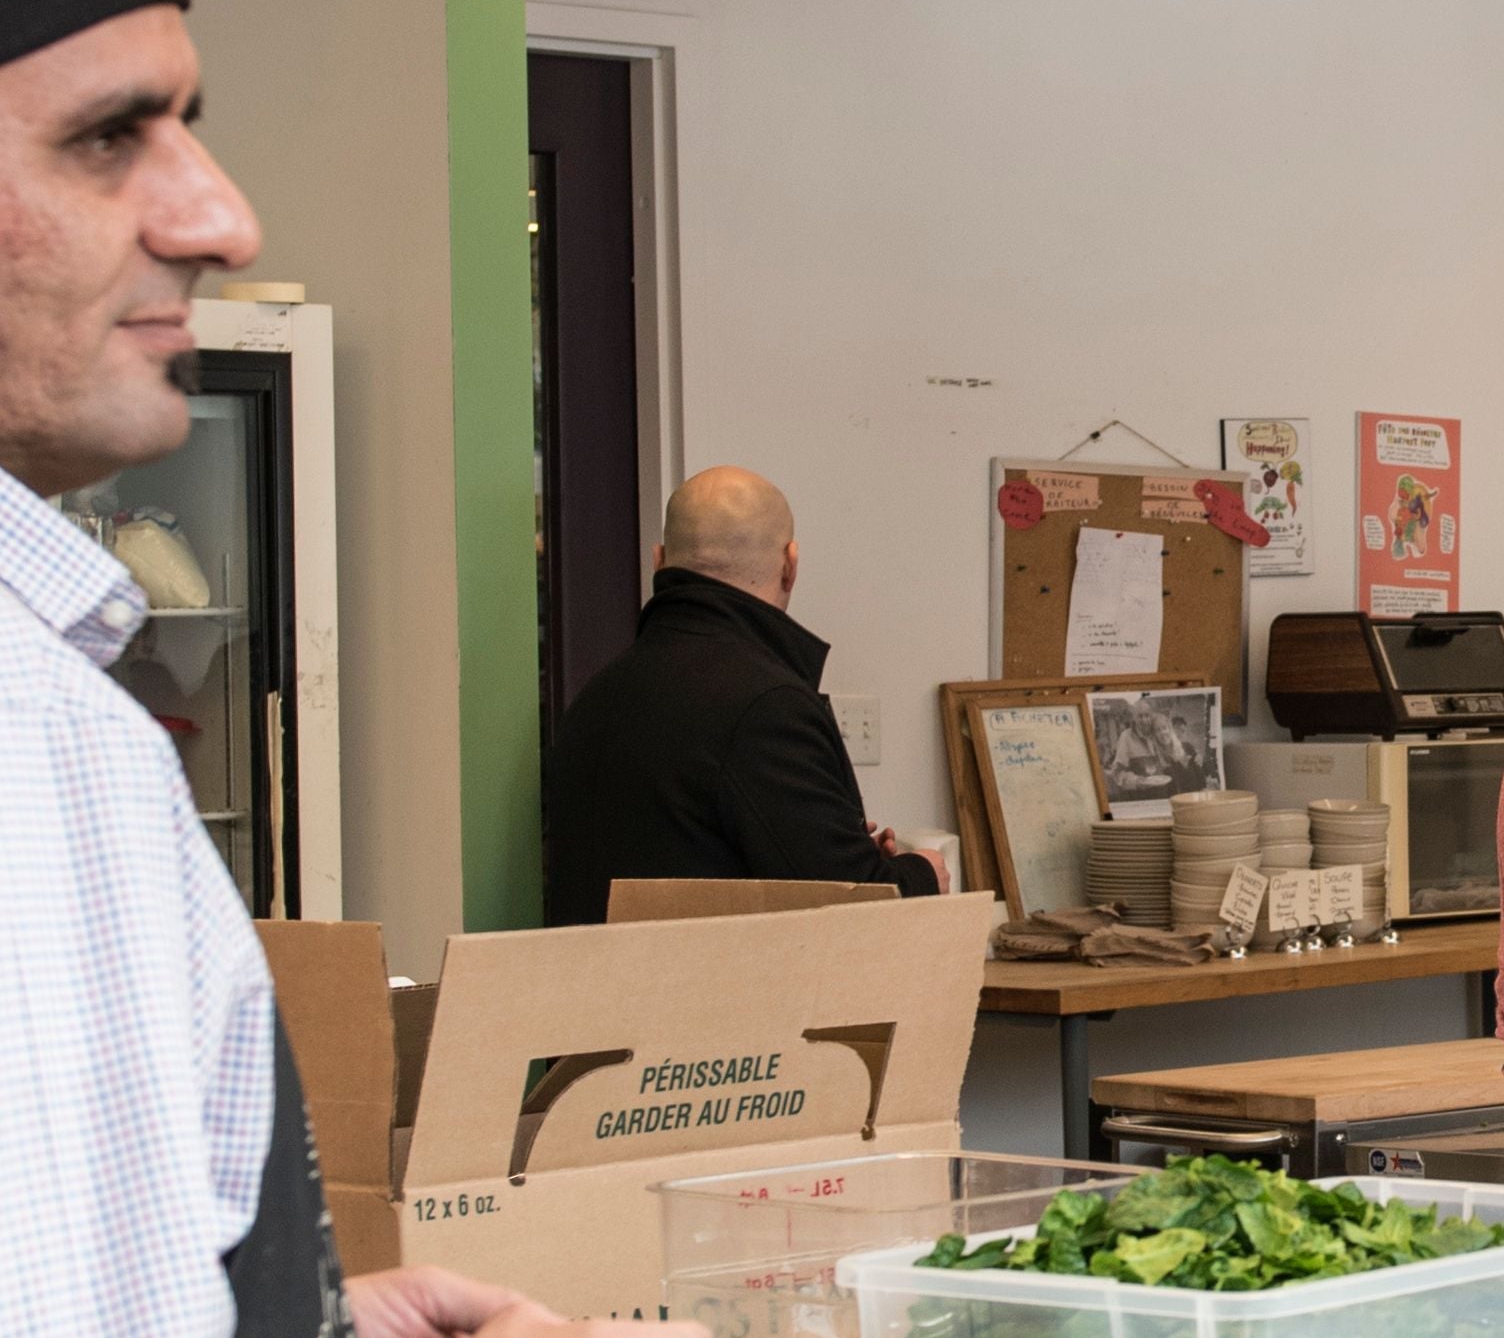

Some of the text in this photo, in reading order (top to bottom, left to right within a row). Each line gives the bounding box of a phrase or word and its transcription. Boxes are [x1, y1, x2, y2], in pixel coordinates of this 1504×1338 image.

[1034, 477, 1082, 489] SERVICE
[1046, 498, 1090, 508] RAITEUR
[639, 1053, 782, 1094] PÉRISSABLE
[596, 1089, 805, 1139] GARDER AU FROID
[414, 1193, 501, 1221] 12 x 6 oz.
